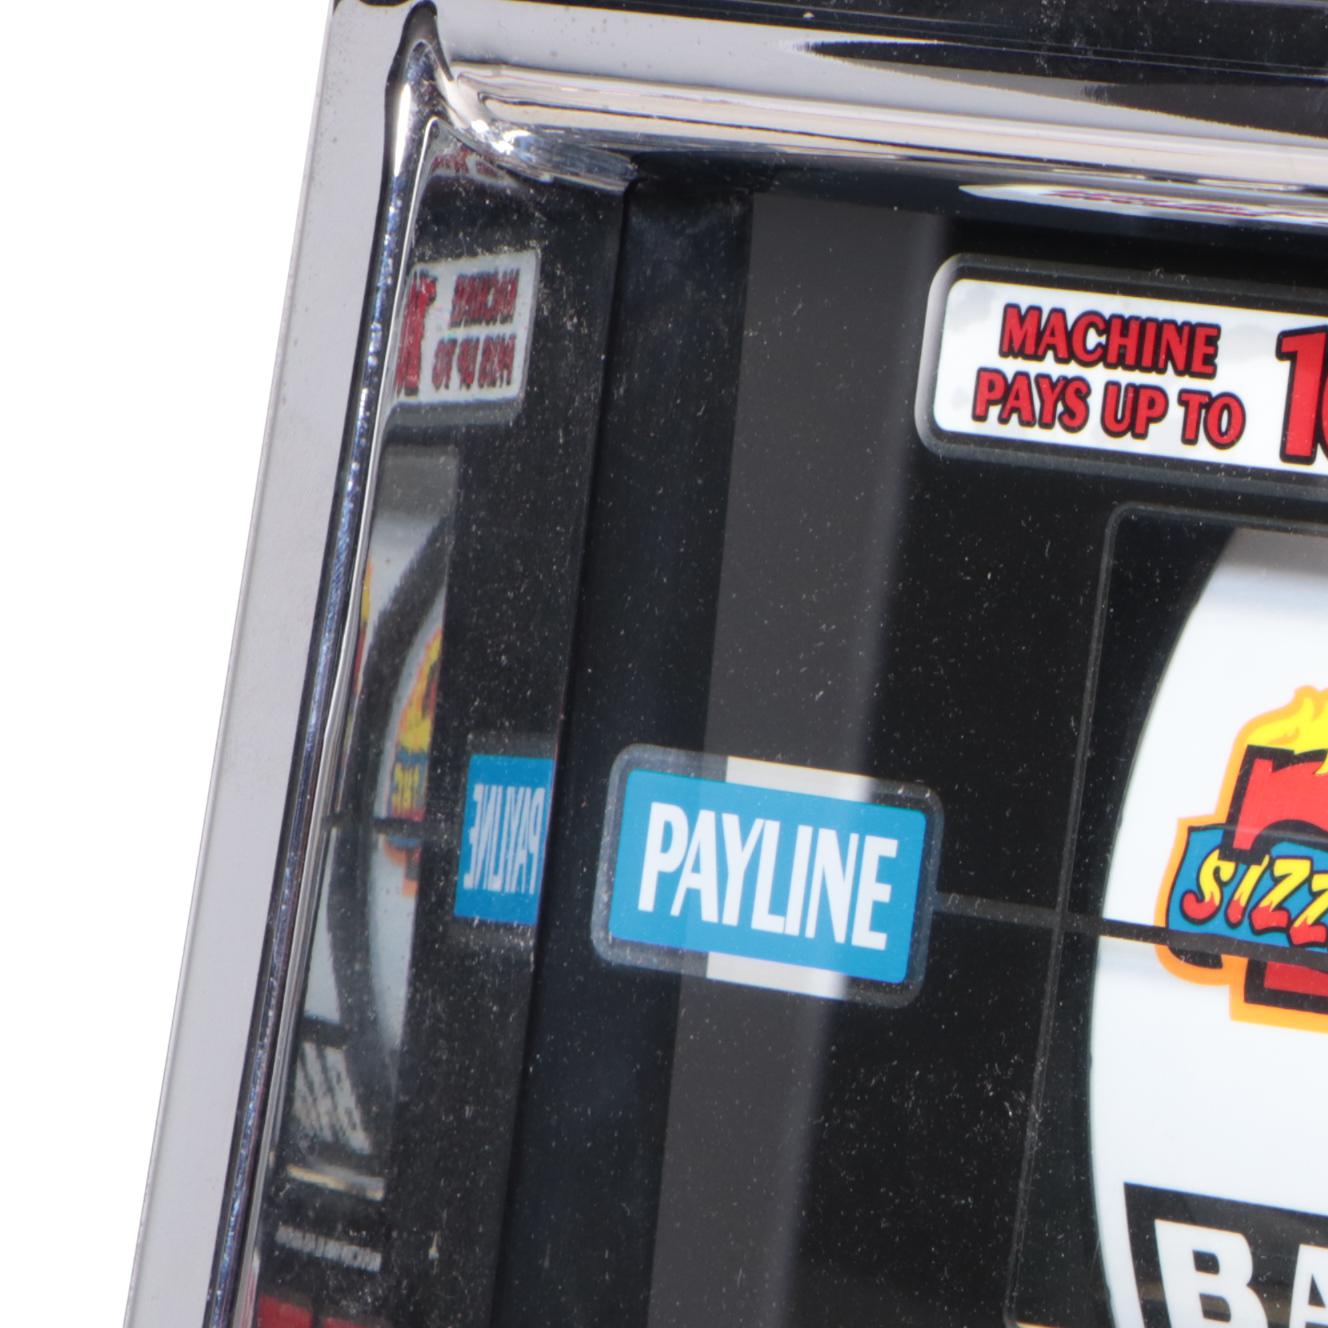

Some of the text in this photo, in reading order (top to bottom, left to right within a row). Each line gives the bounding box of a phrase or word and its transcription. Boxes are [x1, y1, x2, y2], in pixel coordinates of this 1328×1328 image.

[999, 304, 1220, 378] MACHINE
[972, 368, 1246, 449] PAYS UP TO
[638, 801, 898, 950] PAYLINE
